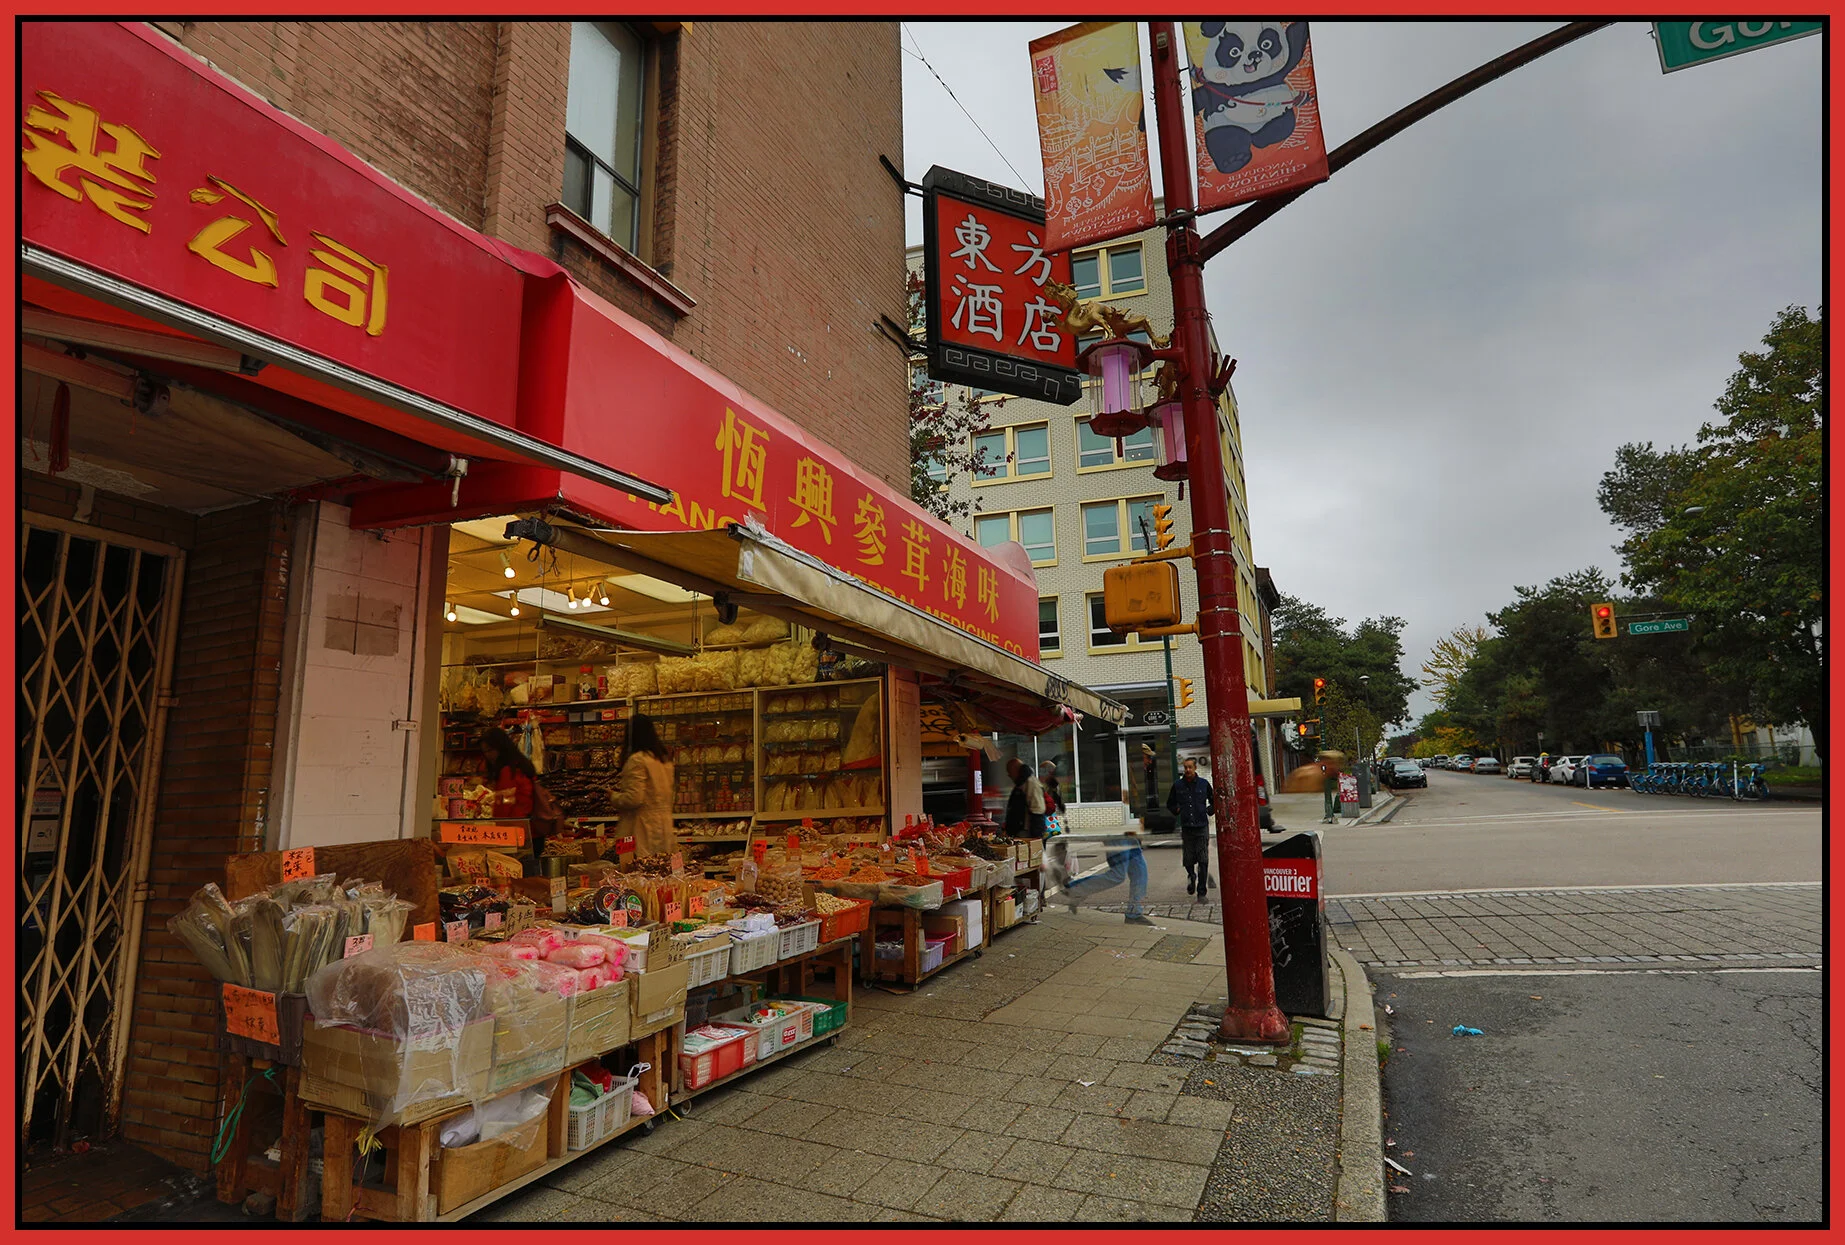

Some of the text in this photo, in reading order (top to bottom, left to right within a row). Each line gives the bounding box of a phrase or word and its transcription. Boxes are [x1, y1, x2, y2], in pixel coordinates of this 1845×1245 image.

[949, 213, 1058, 287] 東方
[950, 274, 1064, 353] 酒店
[1635, 622, 1683, 632] Gore Ave
[1263, 868, 1293, 876] VANCOUVER
[1264, 874, 1312, 893] courier
